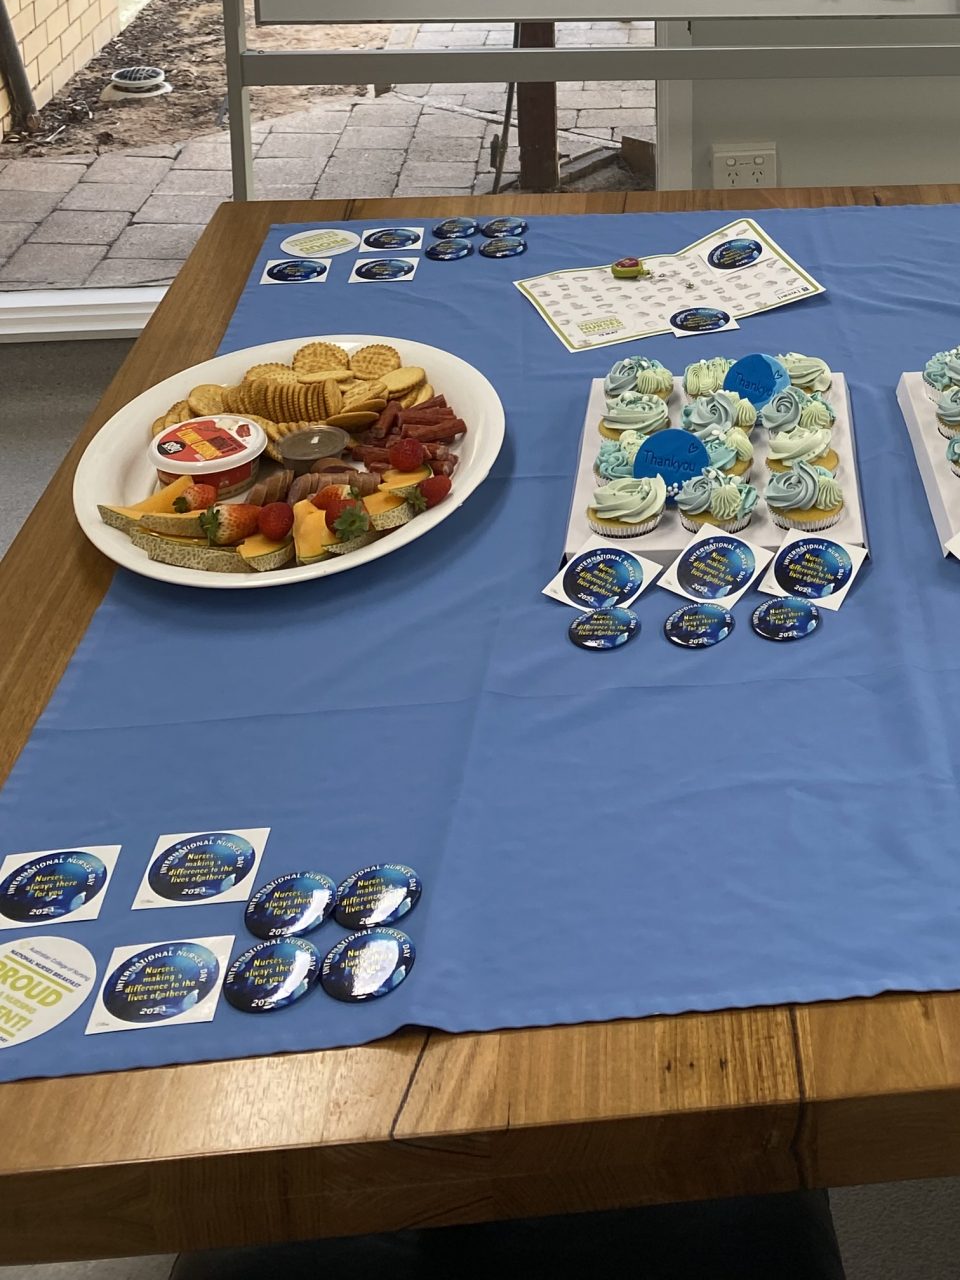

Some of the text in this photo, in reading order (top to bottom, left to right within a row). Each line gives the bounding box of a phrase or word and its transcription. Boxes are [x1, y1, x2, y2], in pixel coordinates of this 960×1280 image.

[643, 449, 696, 472] Thankyou
[160, 839, 214, 874] INTERNATIONAL
[216, 839, 242, 855] NURSES
[7, 858, 64, 894] INTERNATIONAL
[67, 857, 93, 872] NURSES
